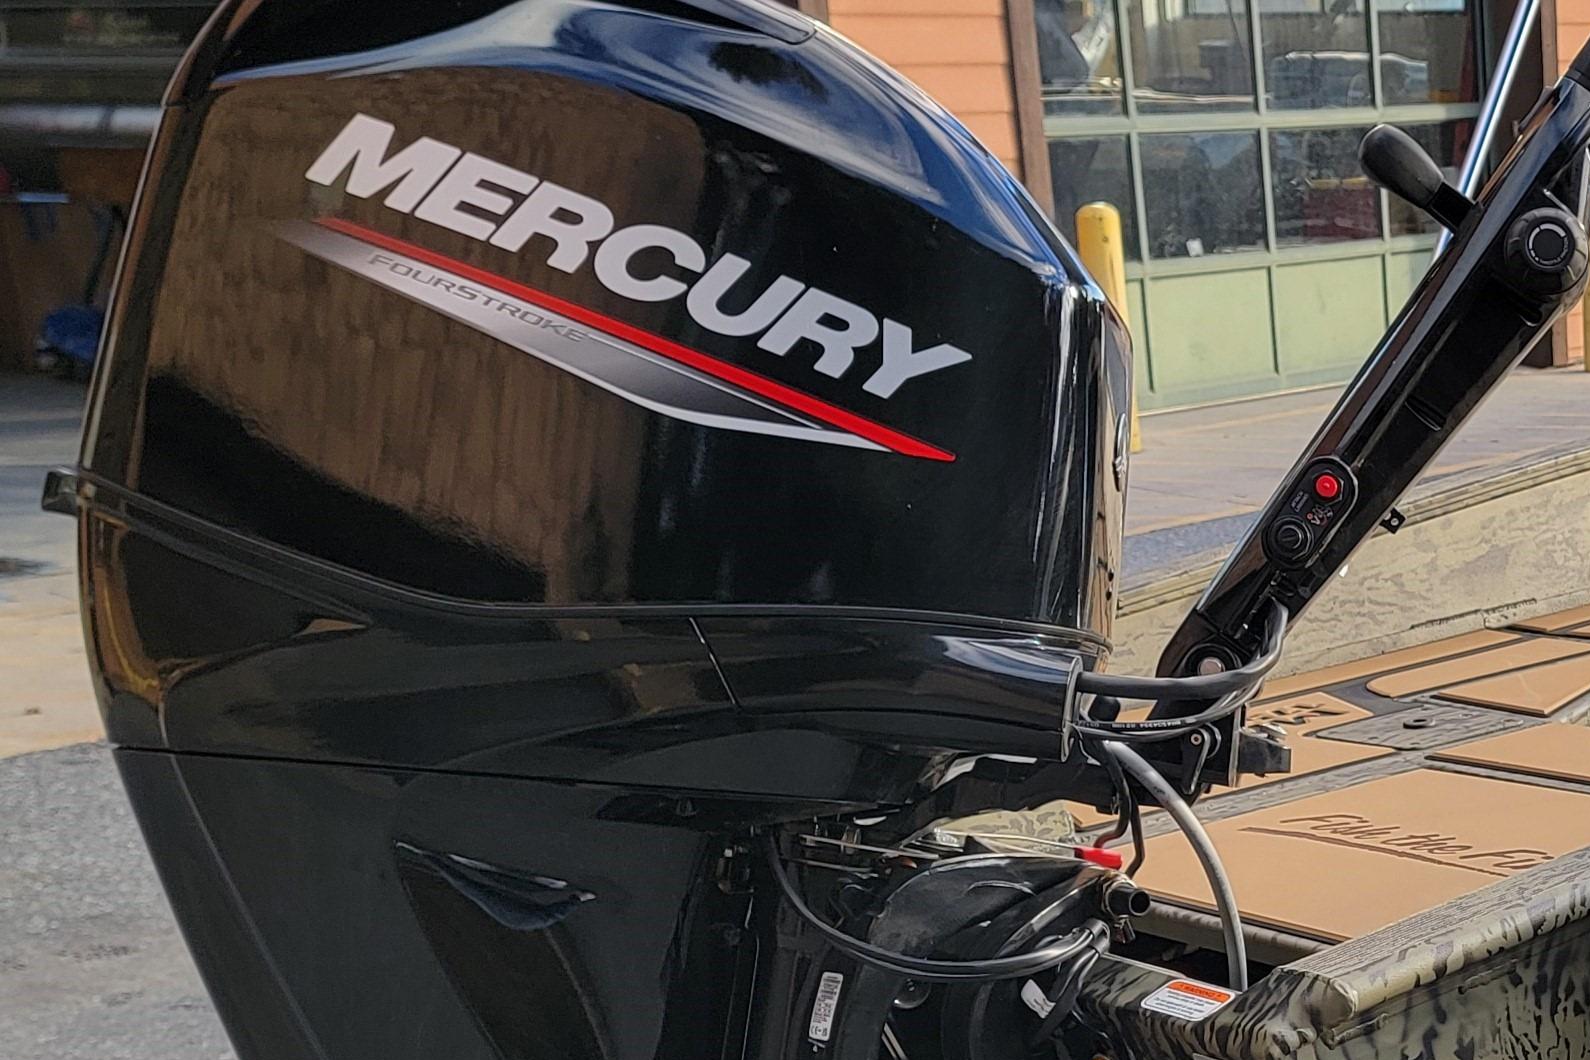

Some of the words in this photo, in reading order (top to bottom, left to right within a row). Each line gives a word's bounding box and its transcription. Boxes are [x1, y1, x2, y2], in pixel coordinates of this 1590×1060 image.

[305, 112, 972, 399] MERCURY
[368, 253, 589, 342] FOURSTROKE
[1279, 813, 1399, 840] Fish
[1380, 834, 1473, 856] the
[1458, 848, 1555, 871] Fi
